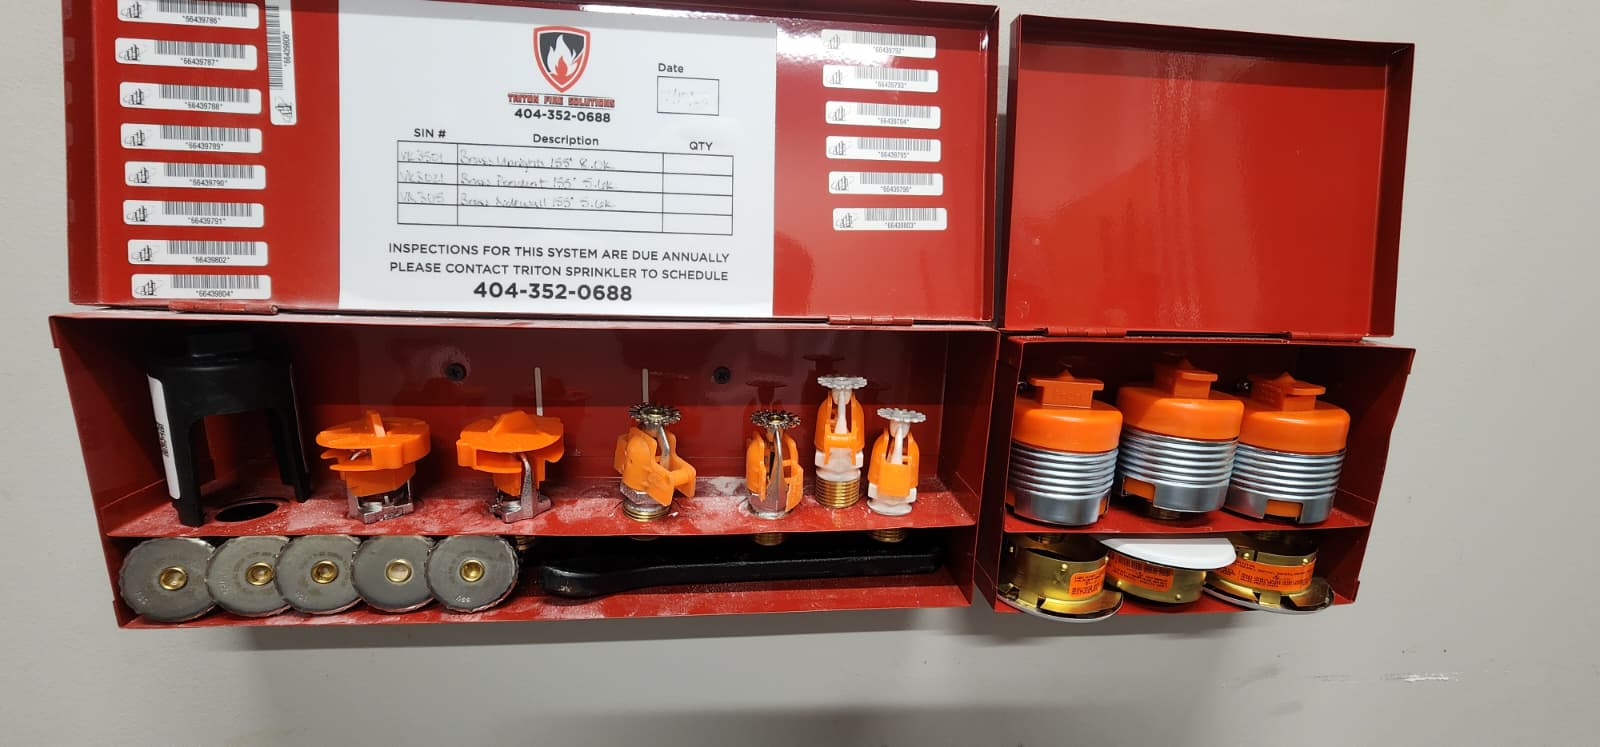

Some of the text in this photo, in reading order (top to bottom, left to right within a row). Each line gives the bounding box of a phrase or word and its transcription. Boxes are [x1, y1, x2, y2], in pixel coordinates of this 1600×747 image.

[658, 63, 684, 73] Date
[508, 93, 615, 108] TRITON FIRE SOLUTIONS
[514, 108, 611, 123] 404-352-0688
[414, 128, 446, 138] SIN #
[533, 134, 599, 146] Description
[689, 141, 713, 151] QTY
[388, 242, 729, 263] INSPECTIONS FOR THIS SYSTEM ARE DUE ANNUALLY
[390, 261, 728, 281] PLEASE CONTACT TRITON SPRINKLER TO SCHEDULE
[473, 281, 632, 301] 404-352-0688
